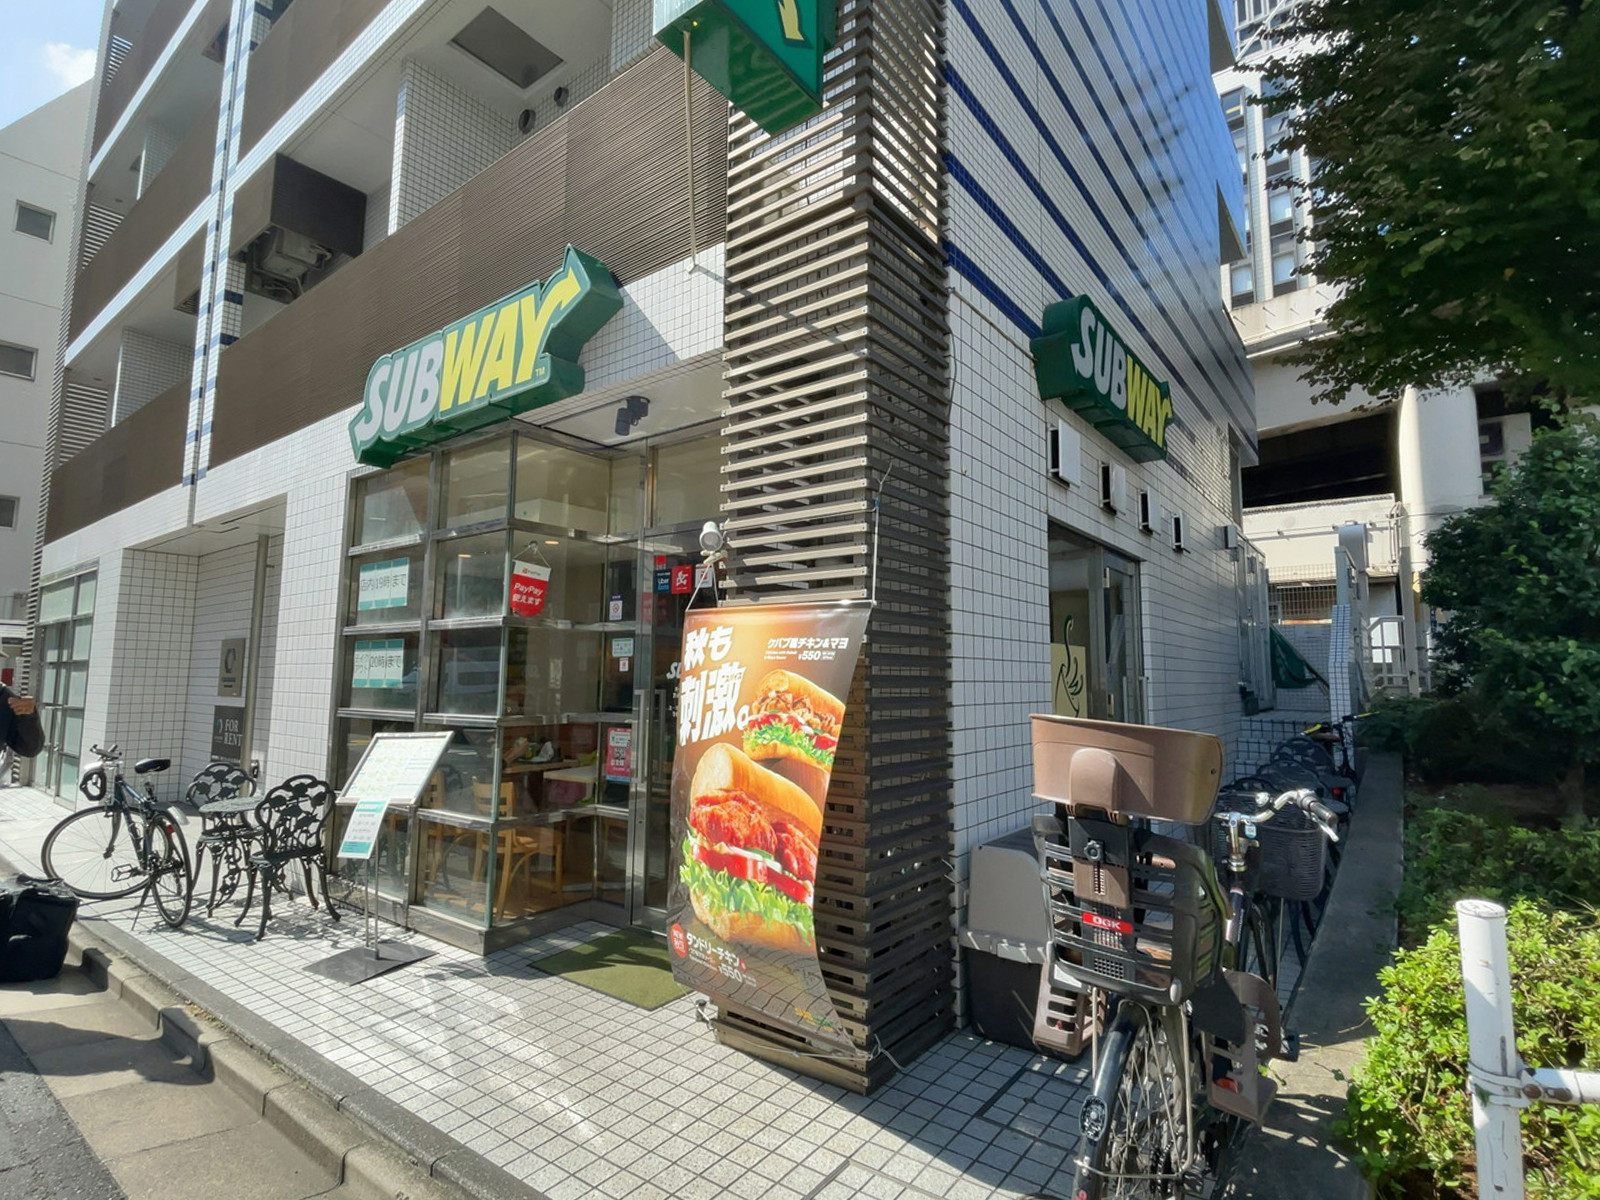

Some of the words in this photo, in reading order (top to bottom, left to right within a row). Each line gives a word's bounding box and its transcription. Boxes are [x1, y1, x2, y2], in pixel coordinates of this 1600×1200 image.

[354, 268, 581, 444] SUBWAY
[1071, 306, 1172, 448] SUBWAY
[514, 583, 543, 596] PayPay
[684, 626, 734, 671] 秋も
[223, 733, 243, 746] RENT
[224, 719, 239, 732] FOR
